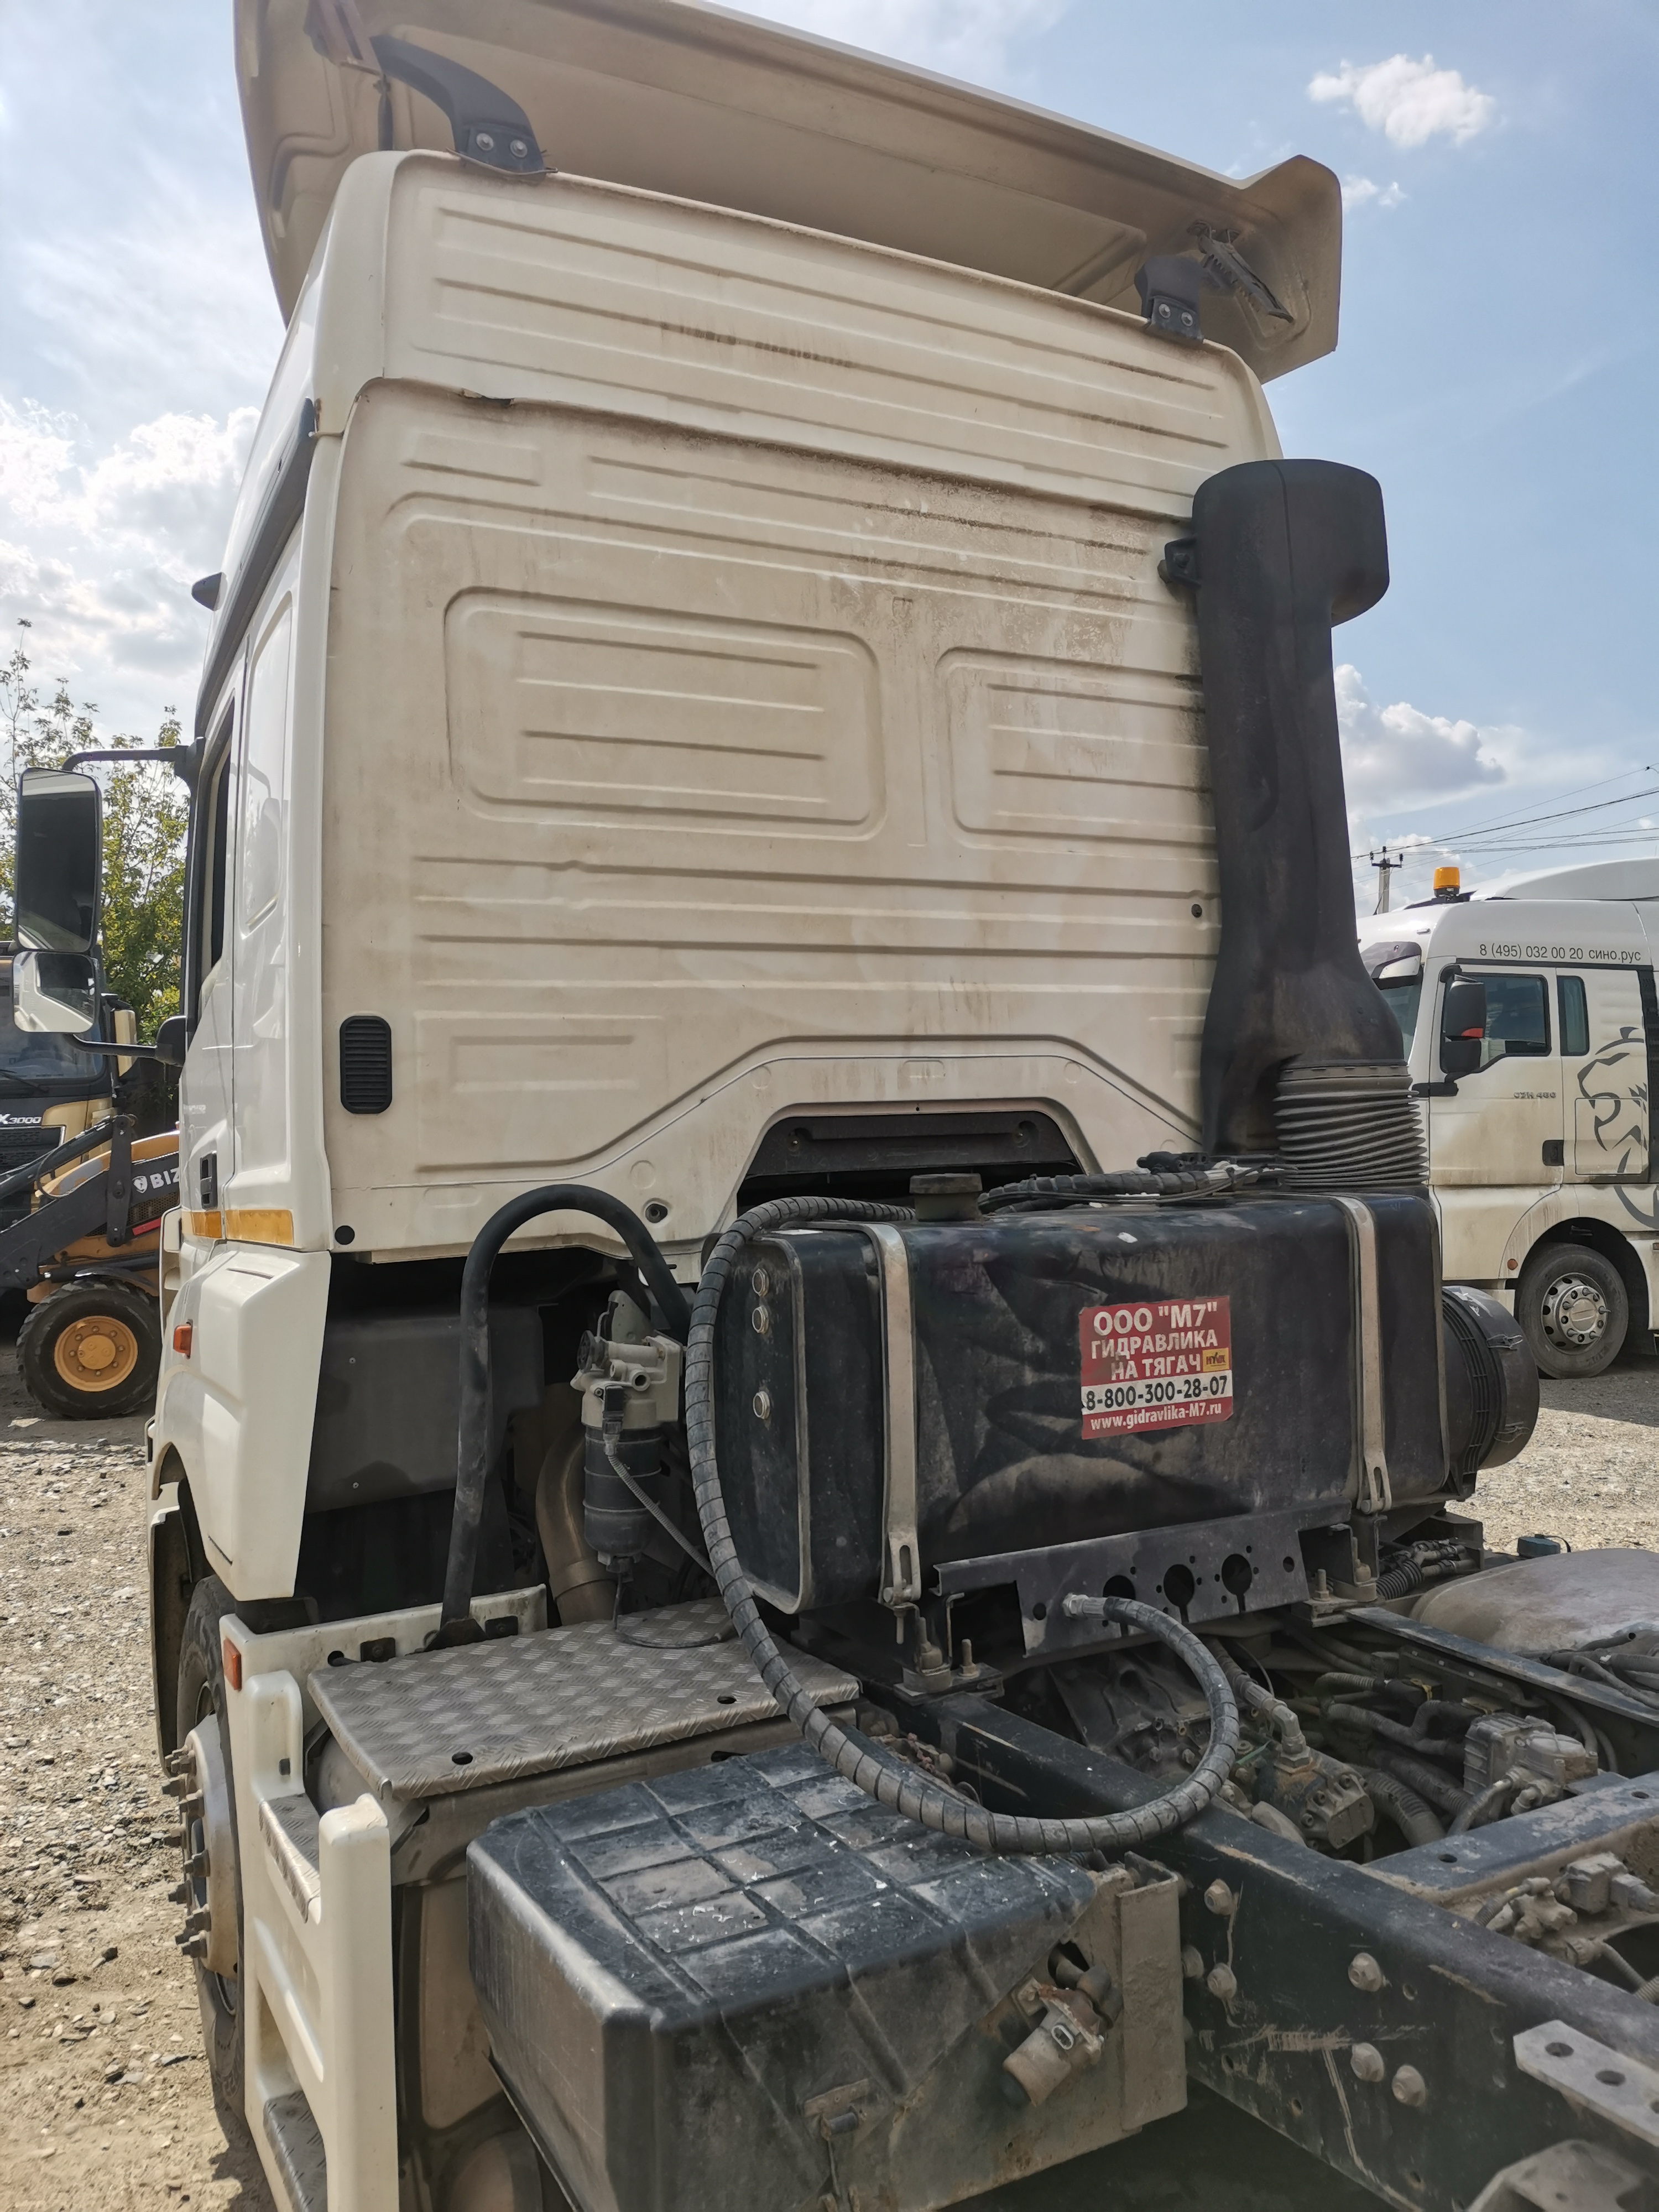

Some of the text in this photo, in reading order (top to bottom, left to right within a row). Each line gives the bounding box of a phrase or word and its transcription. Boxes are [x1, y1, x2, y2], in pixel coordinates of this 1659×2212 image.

[1479, 943, 1641, 963] 8 (495) 032 00 20 сино.рус
[1094, 1301, 1217, 1335] ООО "М7"
[1091, 1329, 1218, 1360] ГИДРАВЛИКА
[1111, 1354, 1201, 1381] НА ТЯГАЧ
[1086, 1375, 1228, 1411] 8-800-300-28-07
[1091, 1402, 1222, 1431] www.gidravlika-M7.ru
